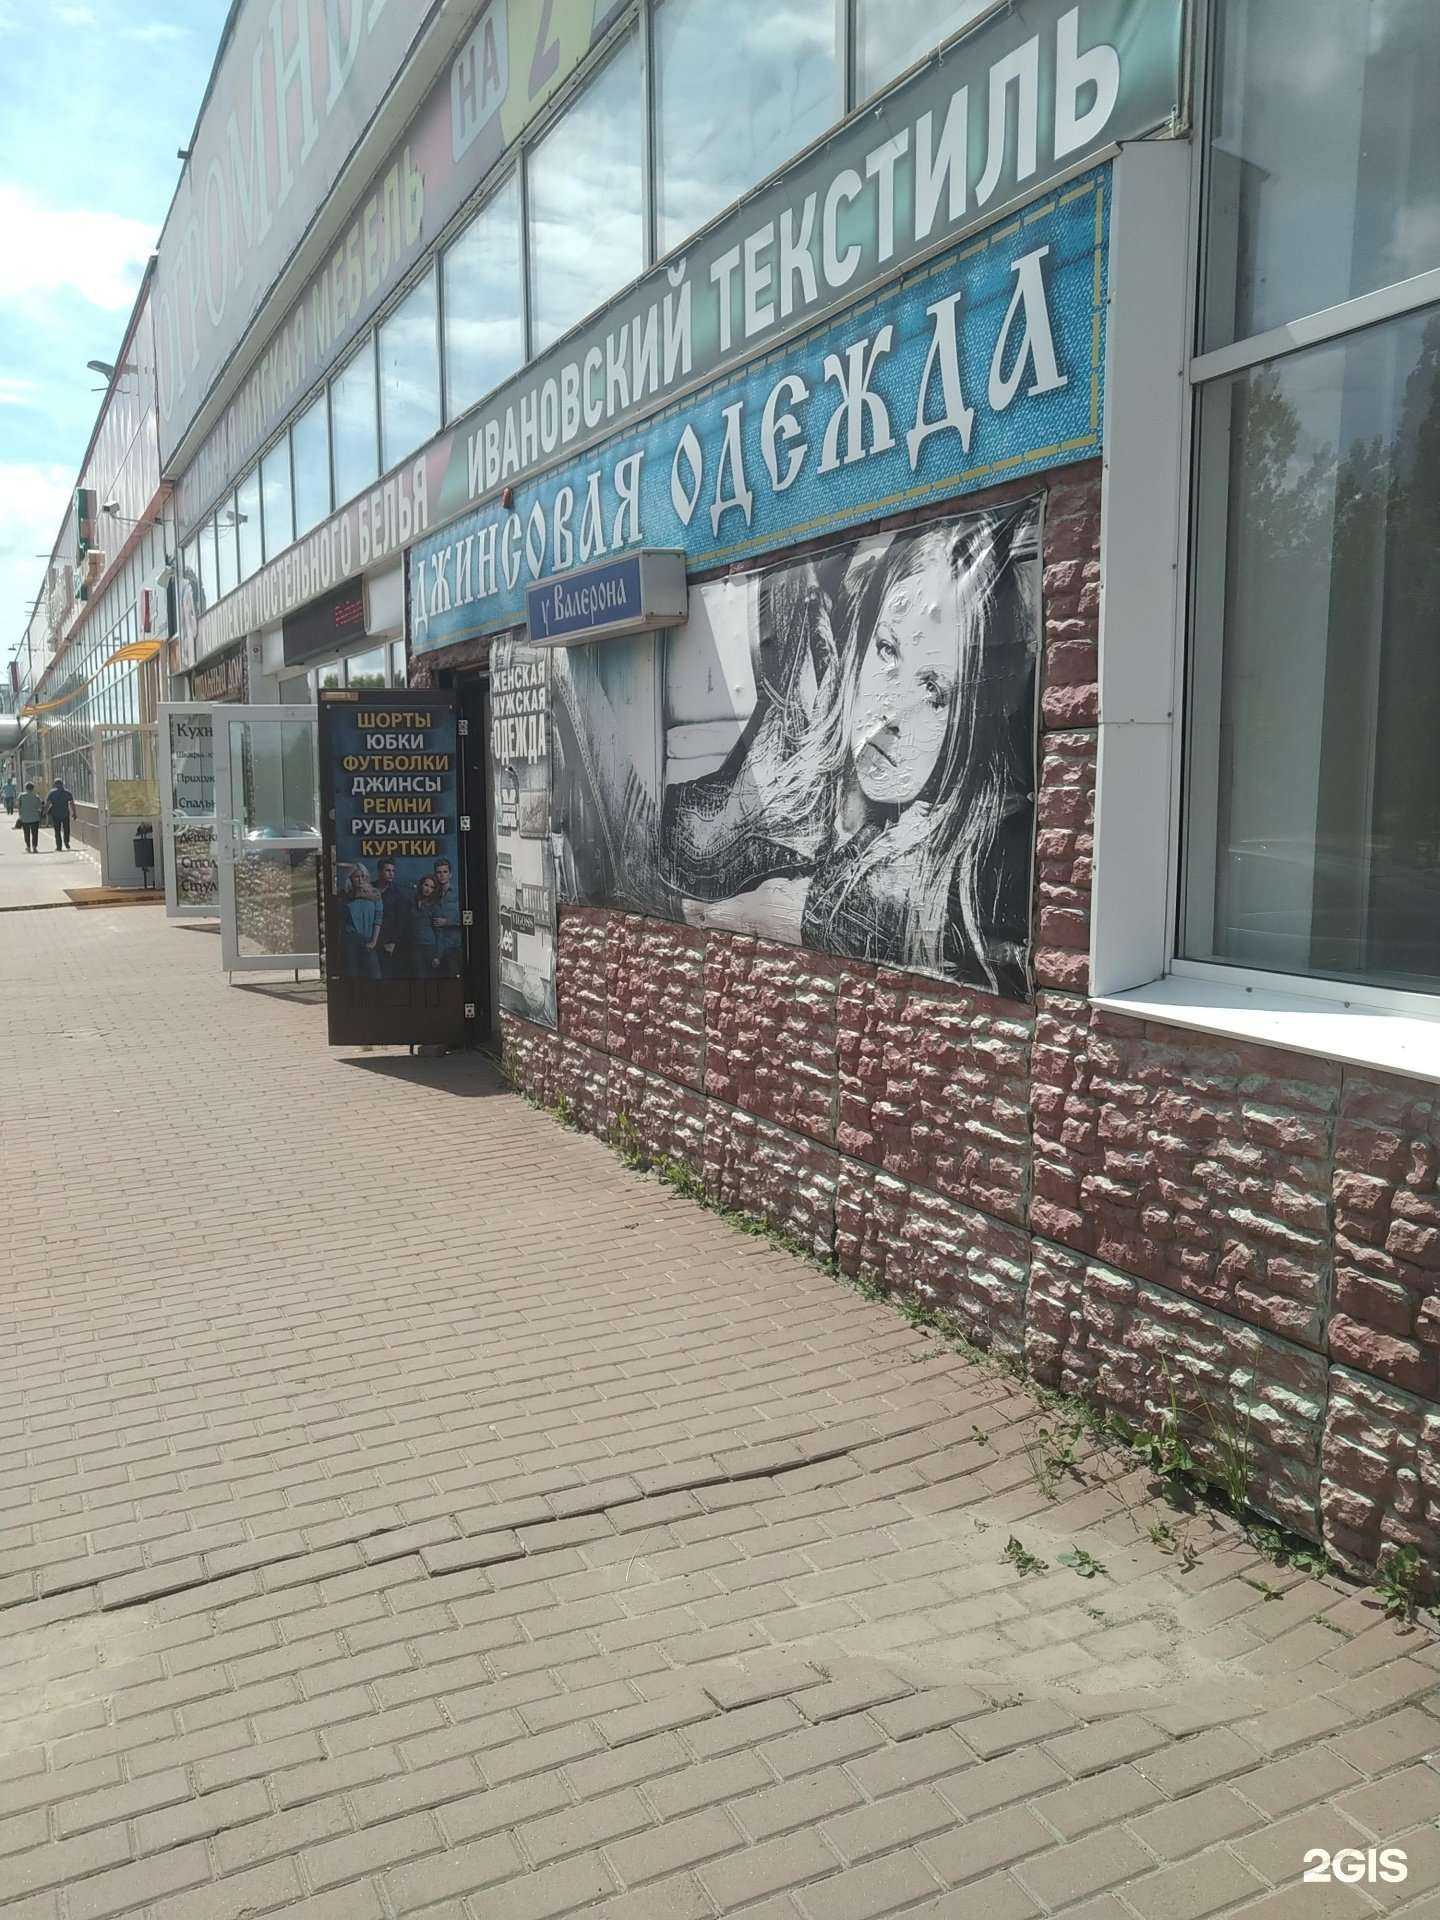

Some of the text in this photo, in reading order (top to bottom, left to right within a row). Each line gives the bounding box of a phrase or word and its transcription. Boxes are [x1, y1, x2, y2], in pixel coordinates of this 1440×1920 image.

[240, 303, 306, 445] МЯГКАЯ
[312, 145, 426, 360] МЕБЕЛЬ
[458, 17, 499, 140] НА
[255, 511, 351, 624] ПОСТЕЛЬНОГО
[359, 455, 429, 566] БЕЛЬЯ
[467, 257, 693, 499] ИВАНОВСКИЙ
[710, 6, 1121, 353] ТЕКСТИЛЬ
[412, 245, 1069, 637] ДЖИНСОВАЯ ОДЕЖДА
[554, 578, 627, 624] Валерона
[492, 660, 546, 694] ЖЕНСКАЯ
[493, 687, 546, 718] МУЖСКАЯ
[357, 713, 431, 728] ШОРТЫ
[177, 723, 213, 739] Кухн
[494, 713, 547, 766] ОДЕЖДА
[366, 734, 424, 750] ЮБКИ
[343, 755, 449, 772] ФУТБОЛКИ
[176, 773, 215, 784] Прихож
[352, 776, 441, 795] ДЖИНСЫ
[363, 799, 432, 814] РЕМНИ
[352, 819, 445, 836] РУБАШКИ
[362, 840, 436, 856] КУРТКИ
[182, 857, 218, 868] Стол
[182, 880, 218, 896] Стул
